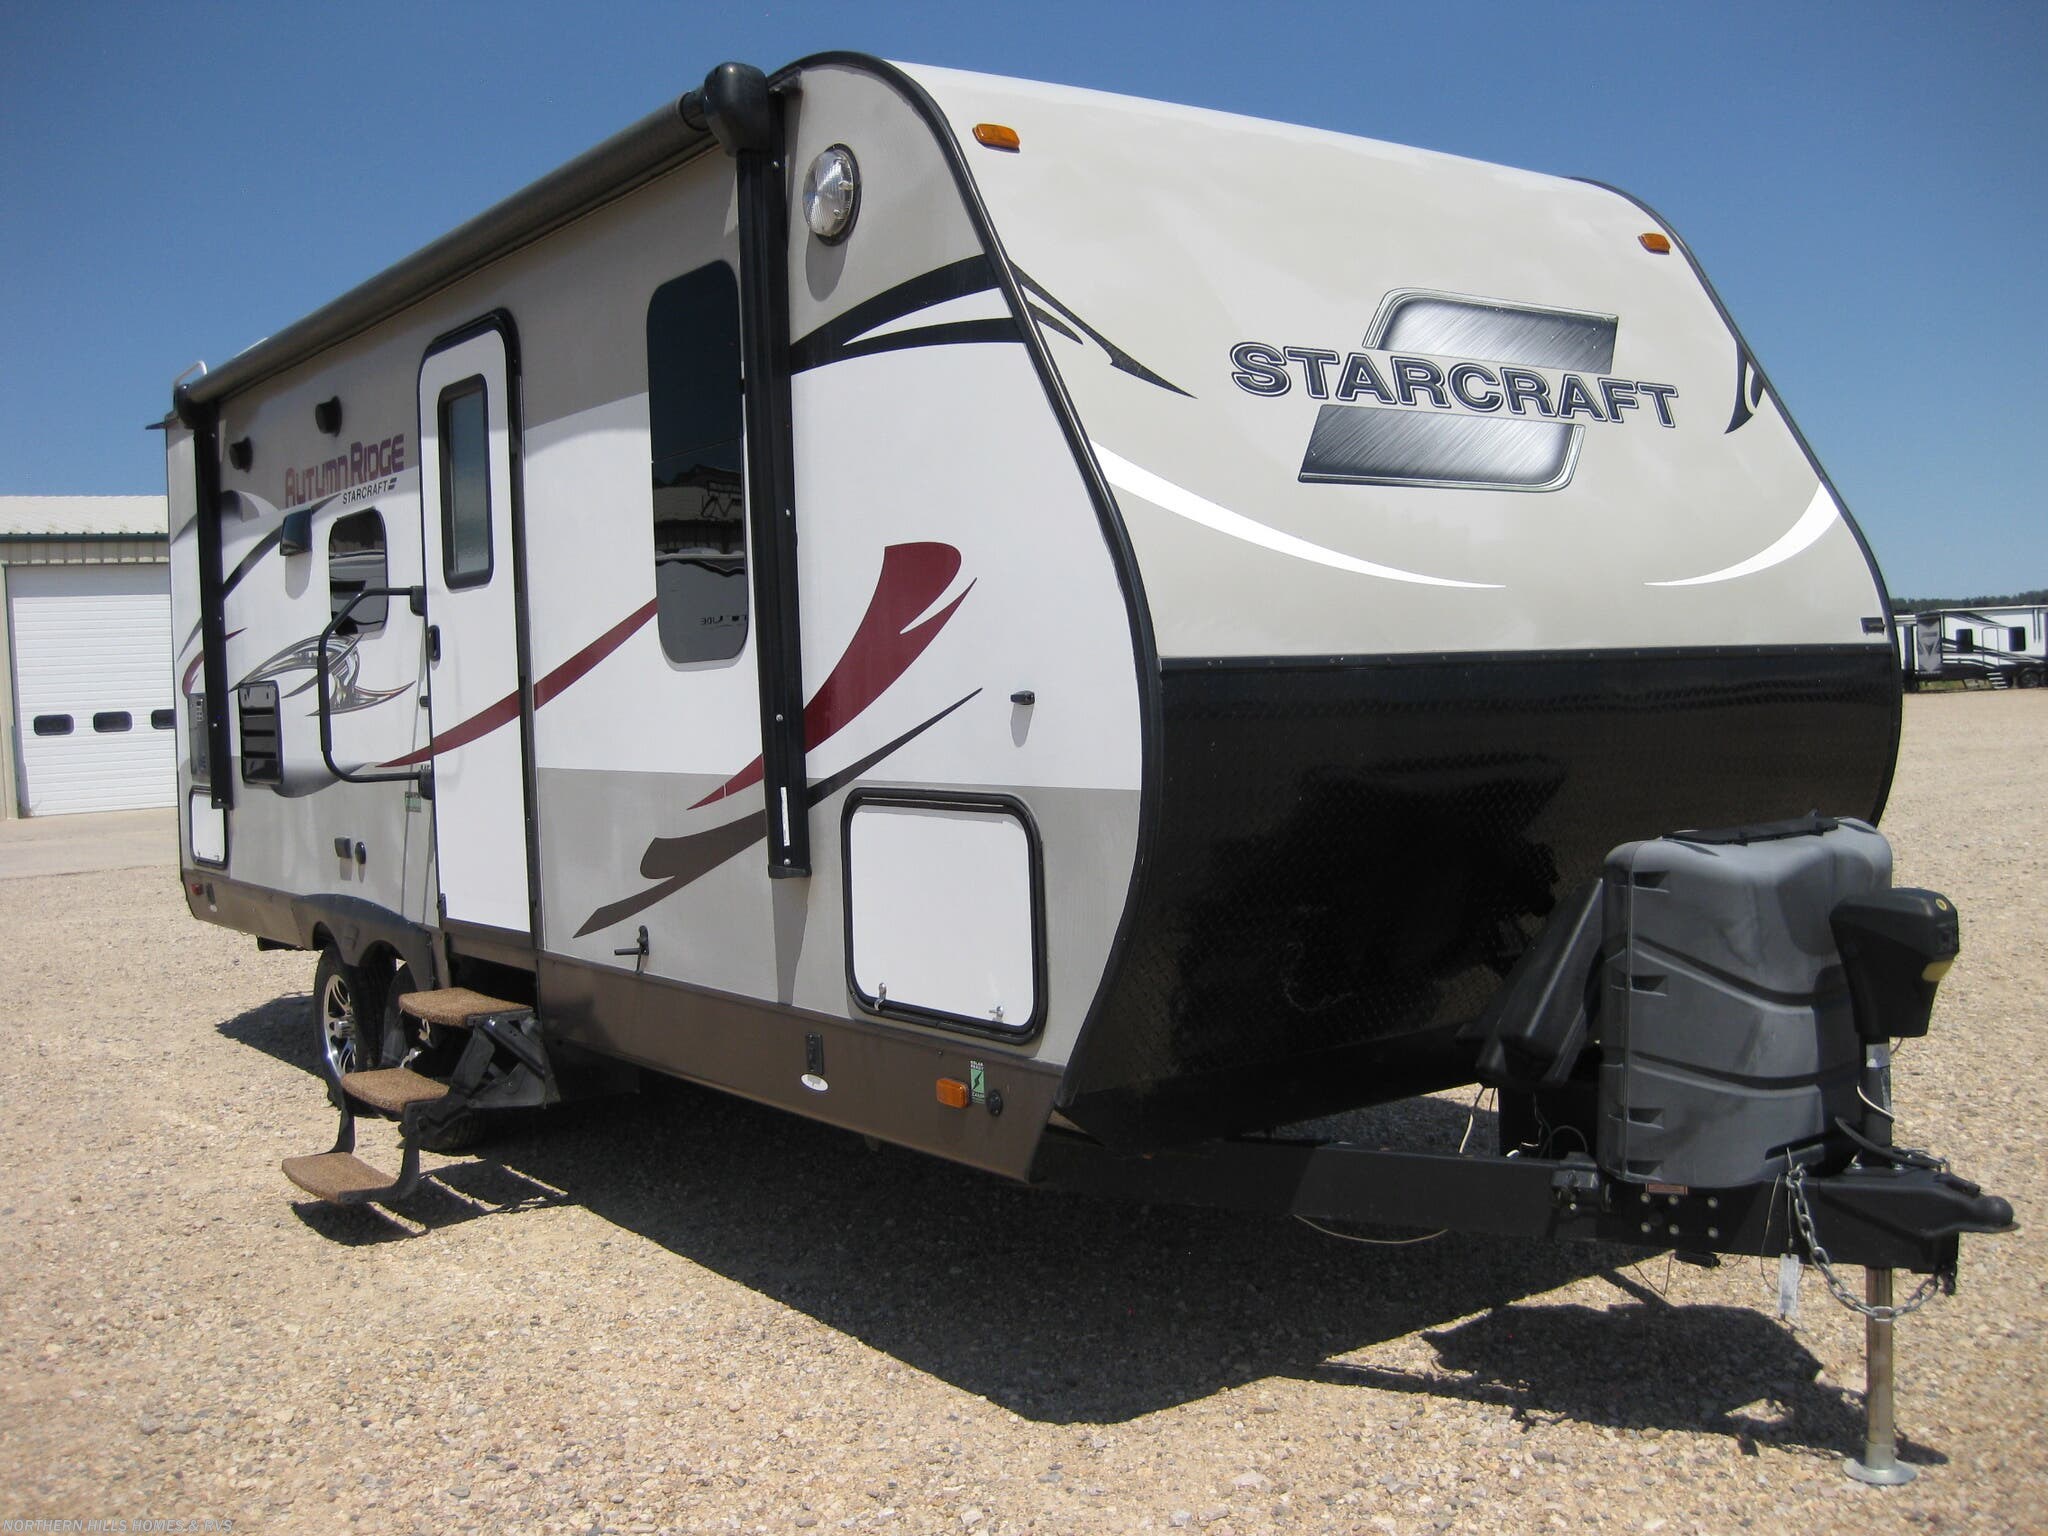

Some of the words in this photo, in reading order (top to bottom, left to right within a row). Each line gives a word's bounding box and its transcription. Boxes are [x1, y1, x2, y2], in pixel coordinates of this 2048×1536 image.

[1230, 342, 1679, 428] STARCRAFT
[350, 434, 404, 487] RIDGE
[342, 480, 388, 504] STARCRAFT
